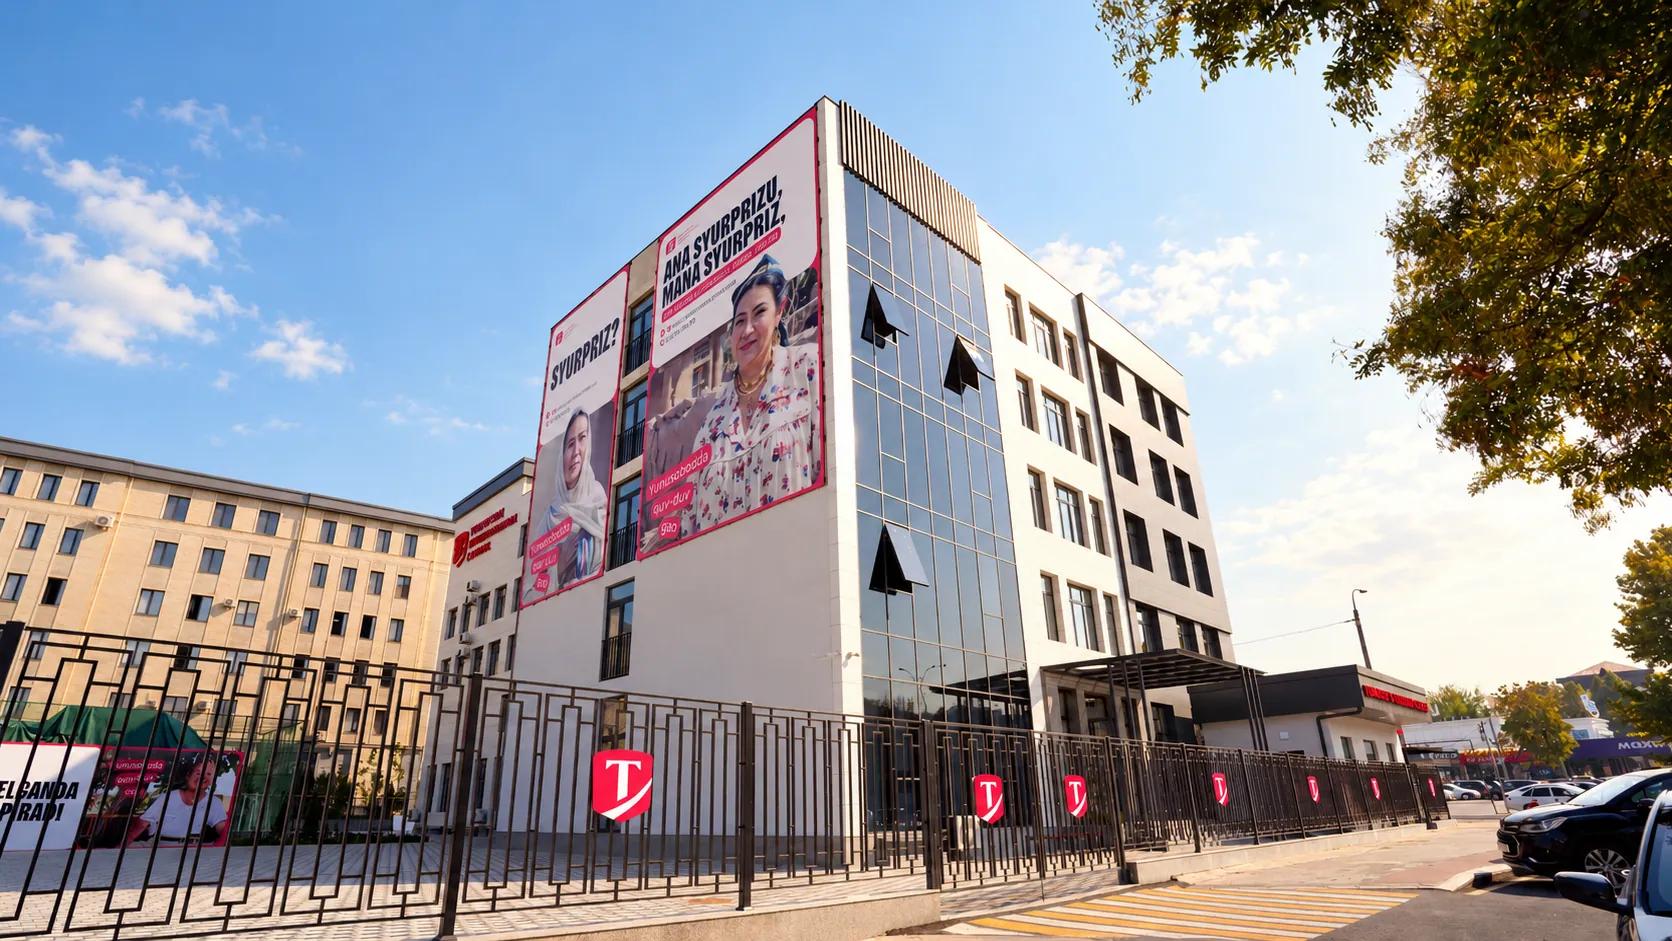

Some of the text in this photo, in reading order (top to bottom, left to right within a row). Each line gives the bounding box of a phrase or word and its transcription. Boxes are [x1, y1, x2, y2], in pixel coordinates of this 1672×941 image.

[662, 262, 700, 309] MANA
[703, 200, 786, 276] SYURPRIZ,
[663, 245, 691, 284] ANA
[693, 175, 783, 259] SYURPRIZU,
[550, 317, 620, 391] SYURPRIZ?
[605, 759, 642, 802] T
[980, 781, 997, 809] T
[1069, 781, 1081, 805] T
